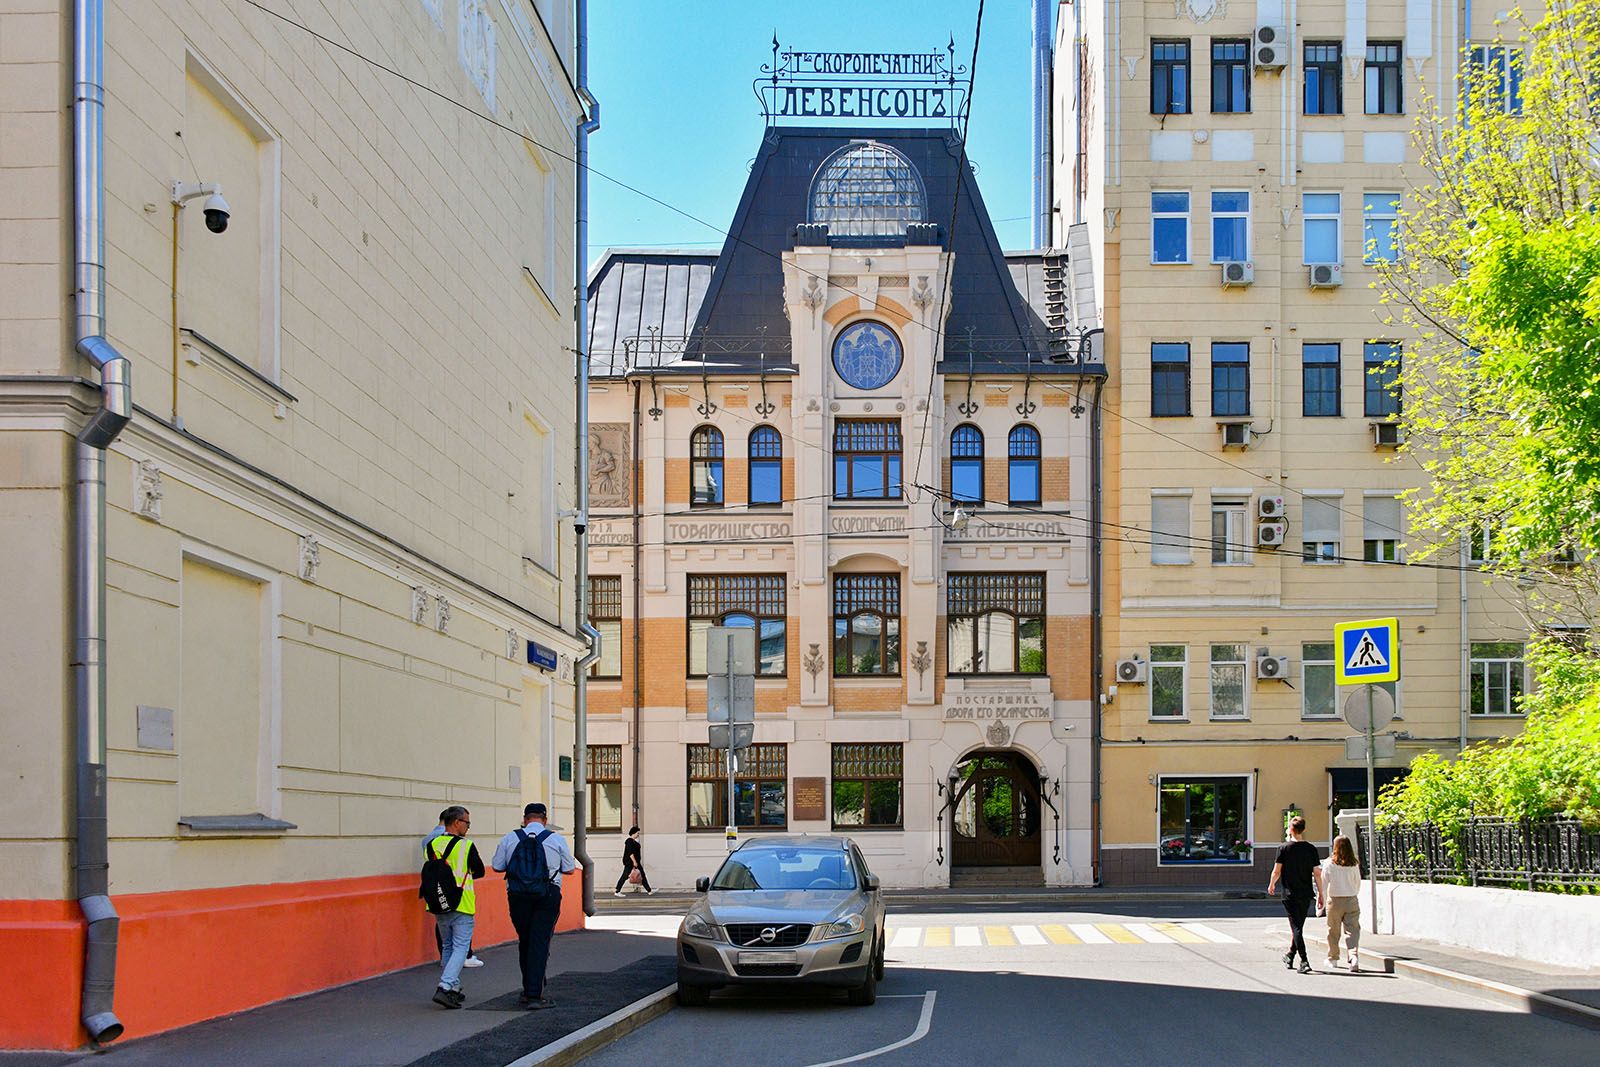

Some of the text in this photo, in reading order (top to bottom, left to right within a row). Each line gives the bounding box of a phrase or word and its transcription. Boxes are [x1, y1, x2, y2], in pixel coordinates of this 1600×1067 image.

[813, 52, 933, 74] СКОРОПЕЧАТНИ
[780, 87, 947, 117] ЛЕВЕНСОНЪ
[669, 522, 791, 540] ТОВАРИЩЕСТВО
[831, 515, 906, 533] СКОРОПЕЧАТНИ
[976, 707, 993, 719] ЕГО
